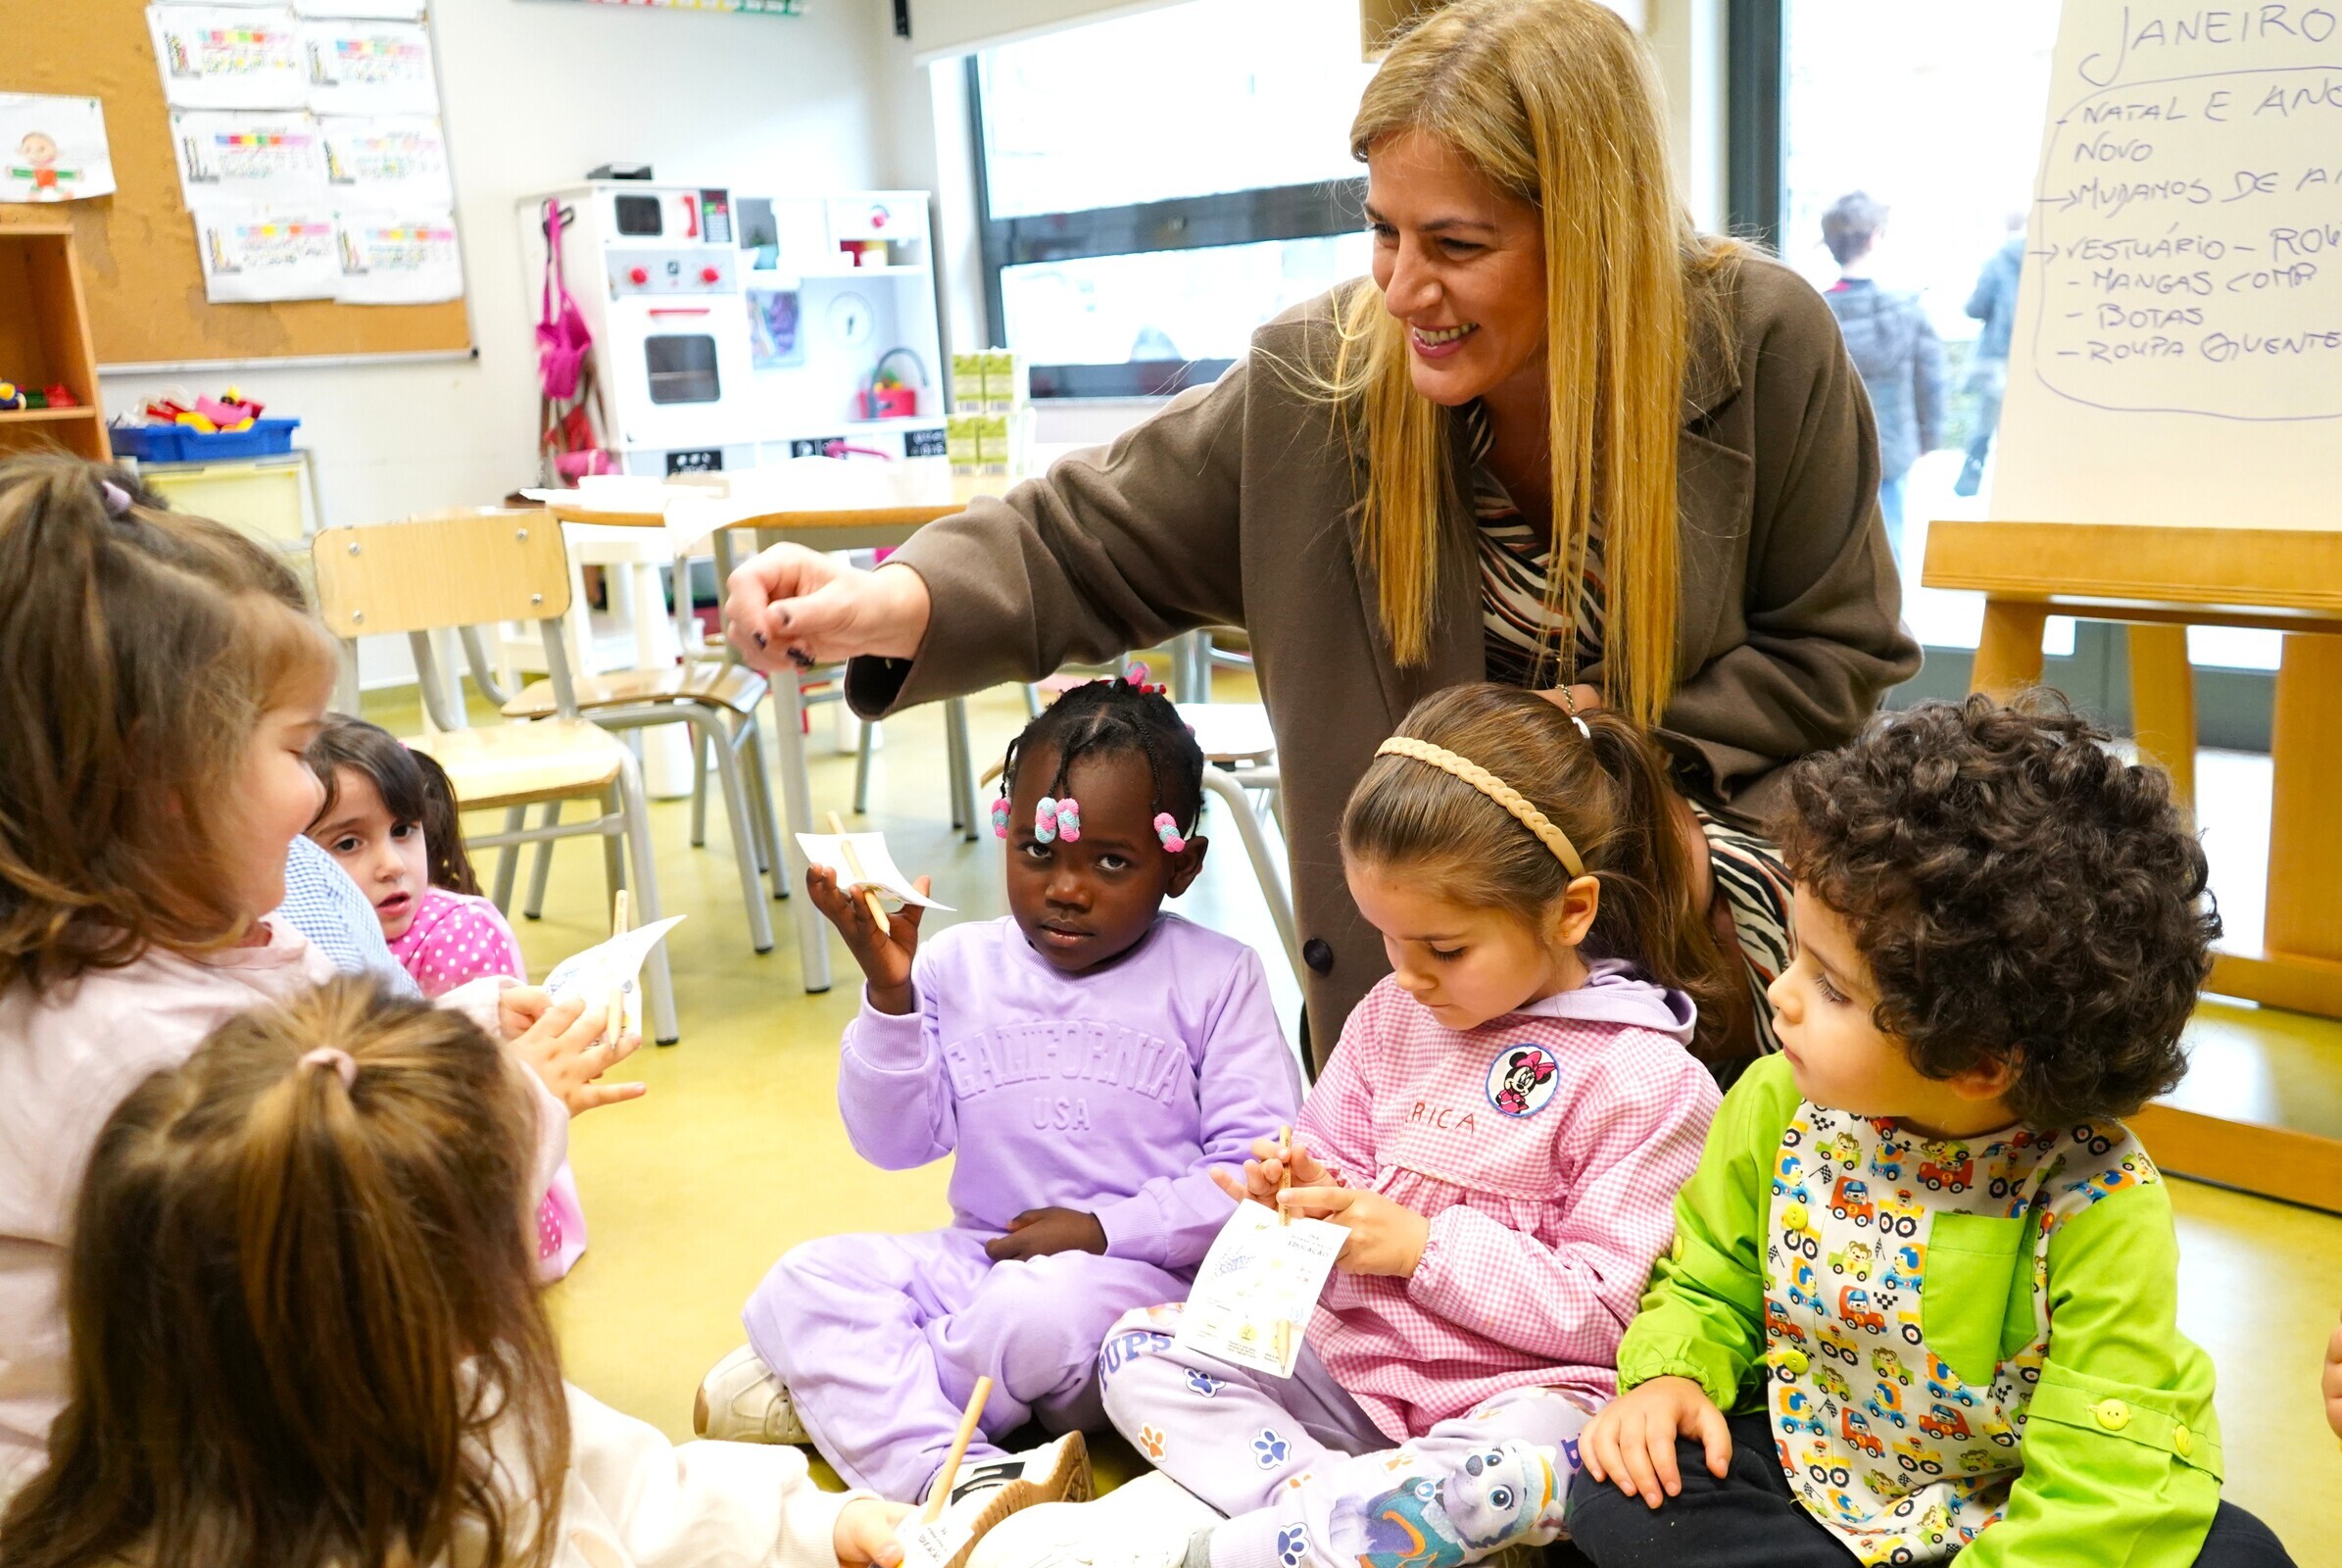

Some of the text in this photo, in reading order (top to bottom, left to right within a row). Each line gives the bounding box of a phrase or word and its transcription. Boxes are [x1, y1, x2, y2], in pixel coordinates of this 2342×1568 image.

[2078, 5, 2336, 87] JANEIRO
[2082, 96, 2187, 124] NATAL
[2205, 91, 2231, 122] E
[2074, 130, 2153, 163] NOVO
[2220, 171, 2278, 203] DE
[2295, 168, 2342, 191] A
[2269, 222, 2342, 263] ROU
[2093, 268, 2213, 296] MANGAS
[2097, 303, 2204, 329] BOTAS
[2088, 337, 2184, 365] ROUPA
[944, 1019, 1187, 1104] CALIFORNIA
[1033, 1097, 1091, 1131] USA
[1405, 1102, 1475, 1135] RICA
